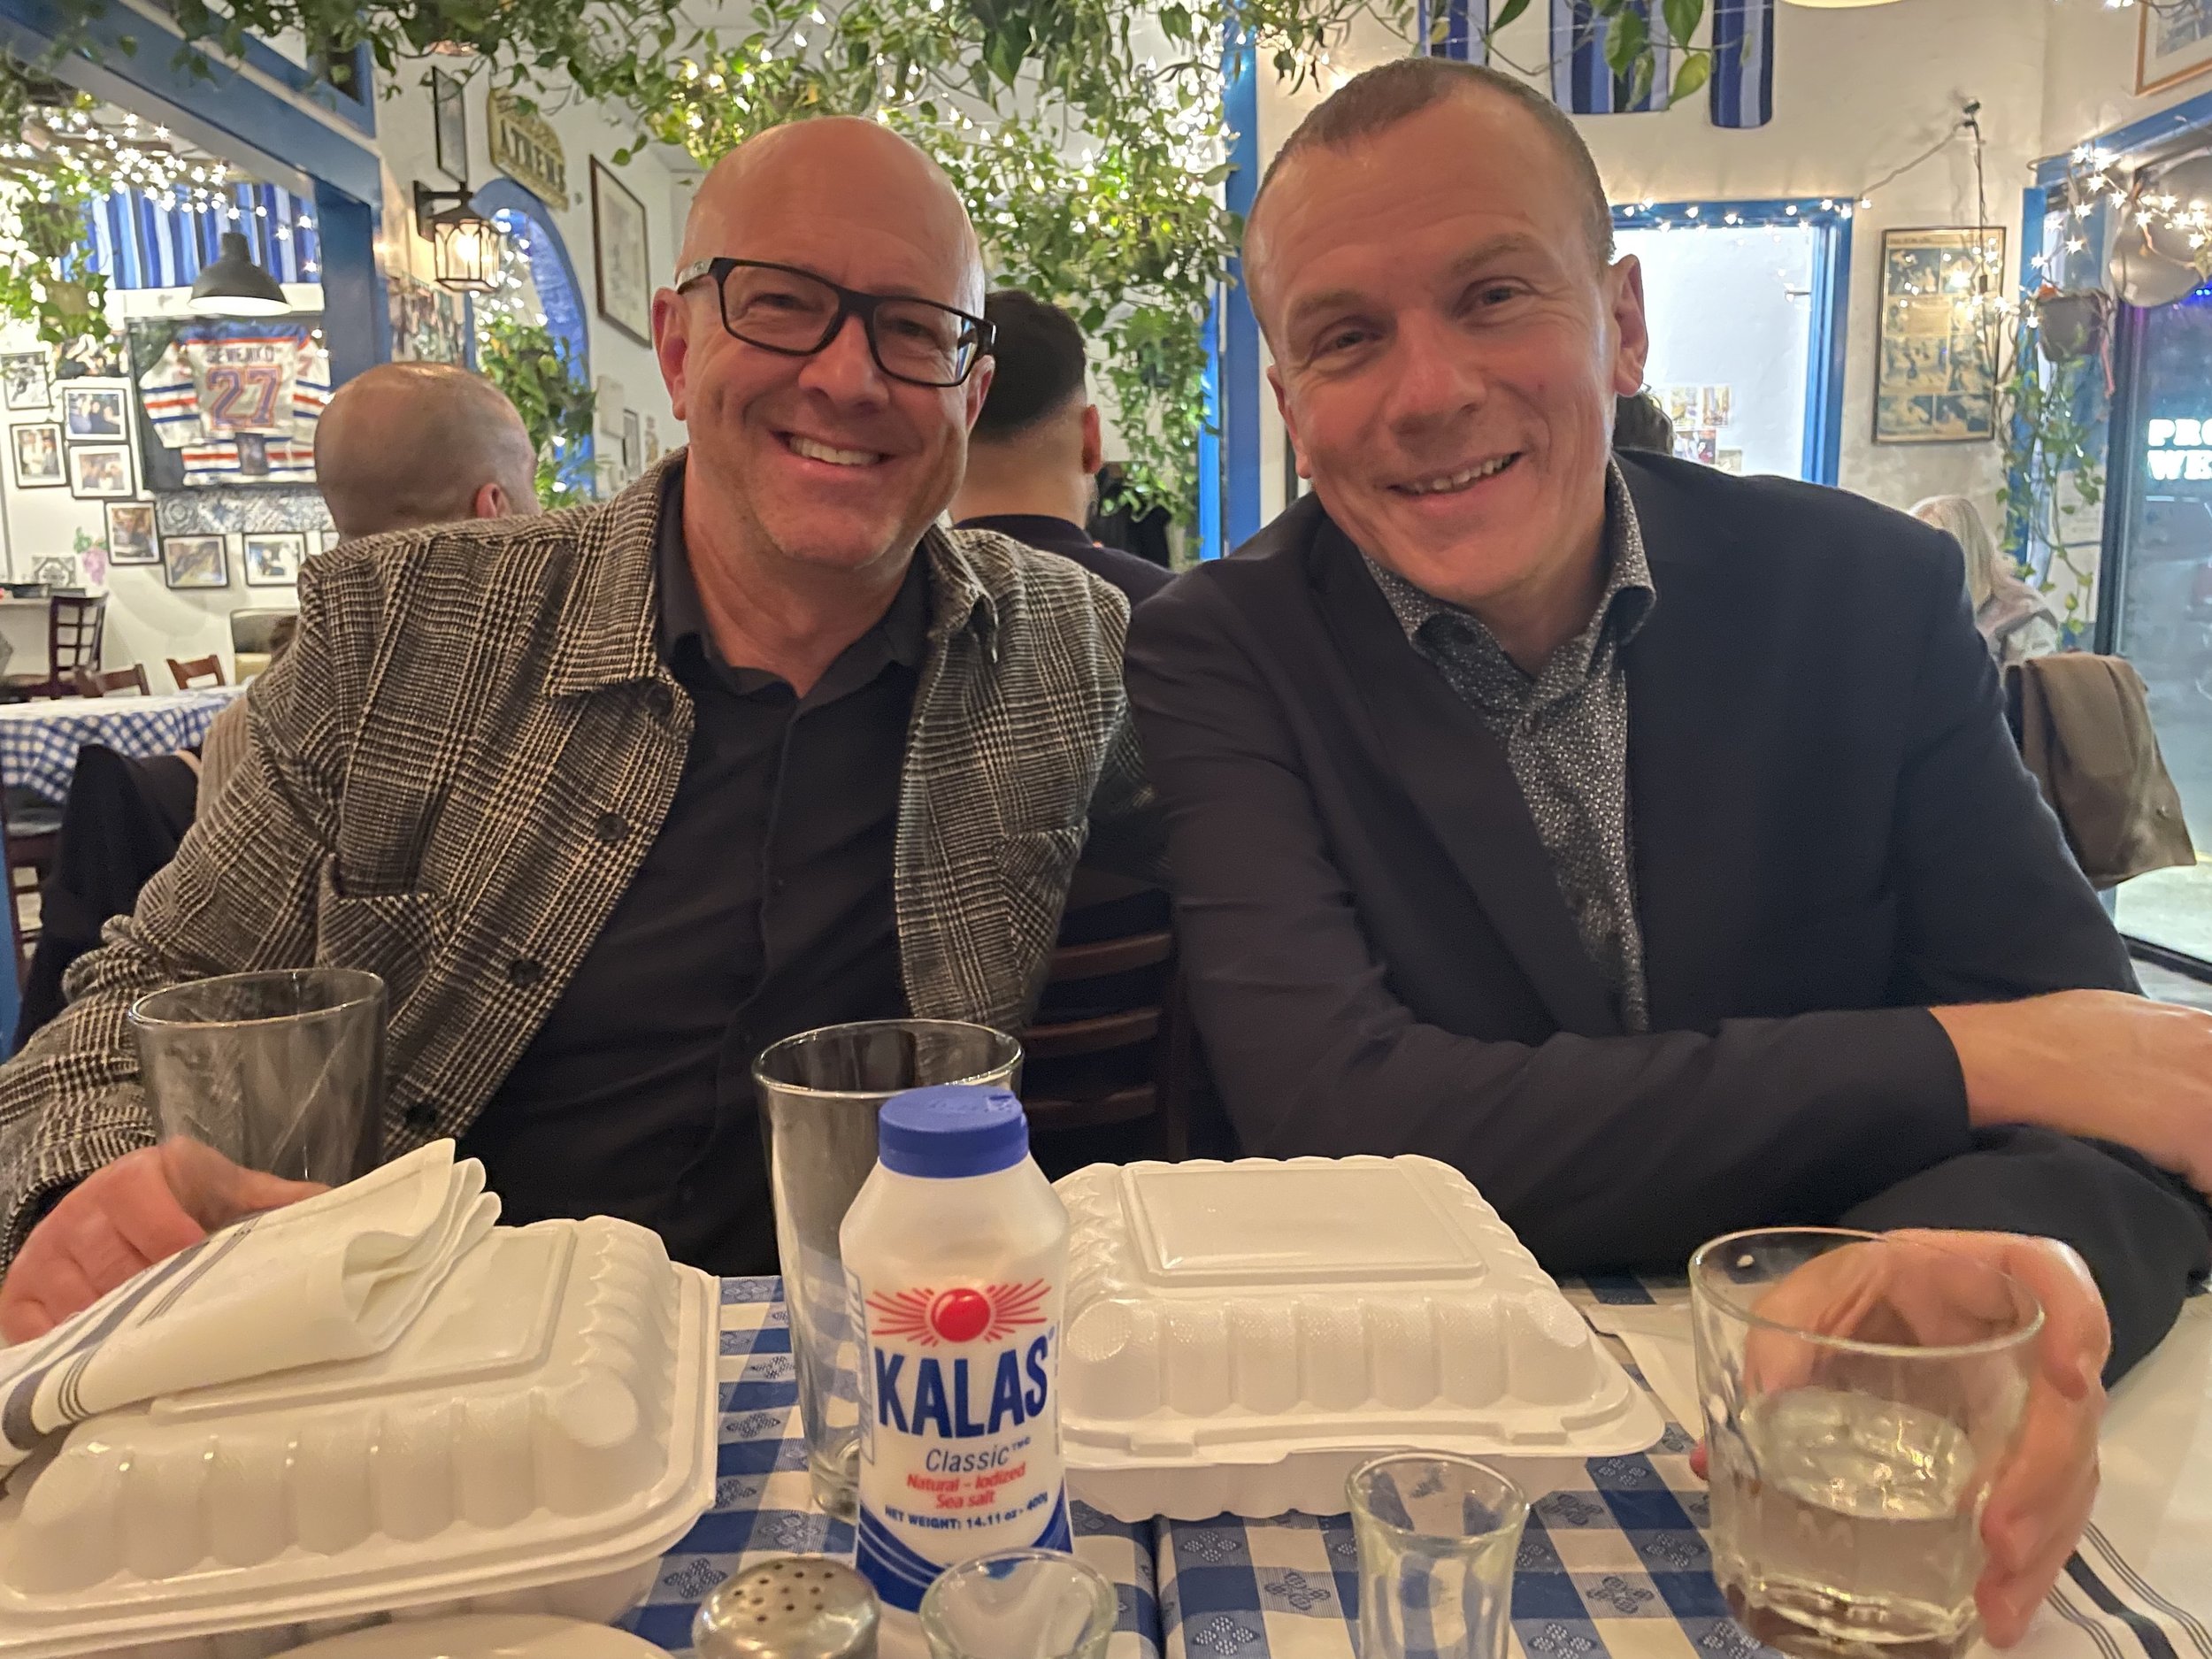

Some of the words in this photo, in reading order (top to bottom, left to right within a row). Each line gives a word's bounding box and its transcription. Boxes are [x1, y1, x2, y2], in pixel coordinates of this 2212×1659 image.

[205, 366, 282, 430] 27
[874, 1335, 1048, 1439] KALAS
[926, 1444, 1010, 1472] Classic
[907, 1473, 960, 1492] Natural
[936, 1494, 964, 1509] Sea
[968, 1490, 995, 1507] salt
[885, 1505, 903, 1522] NET
[966, 1512, 1001, 1529] 14.11
[1004, 1509, 1017, 1520] oz
